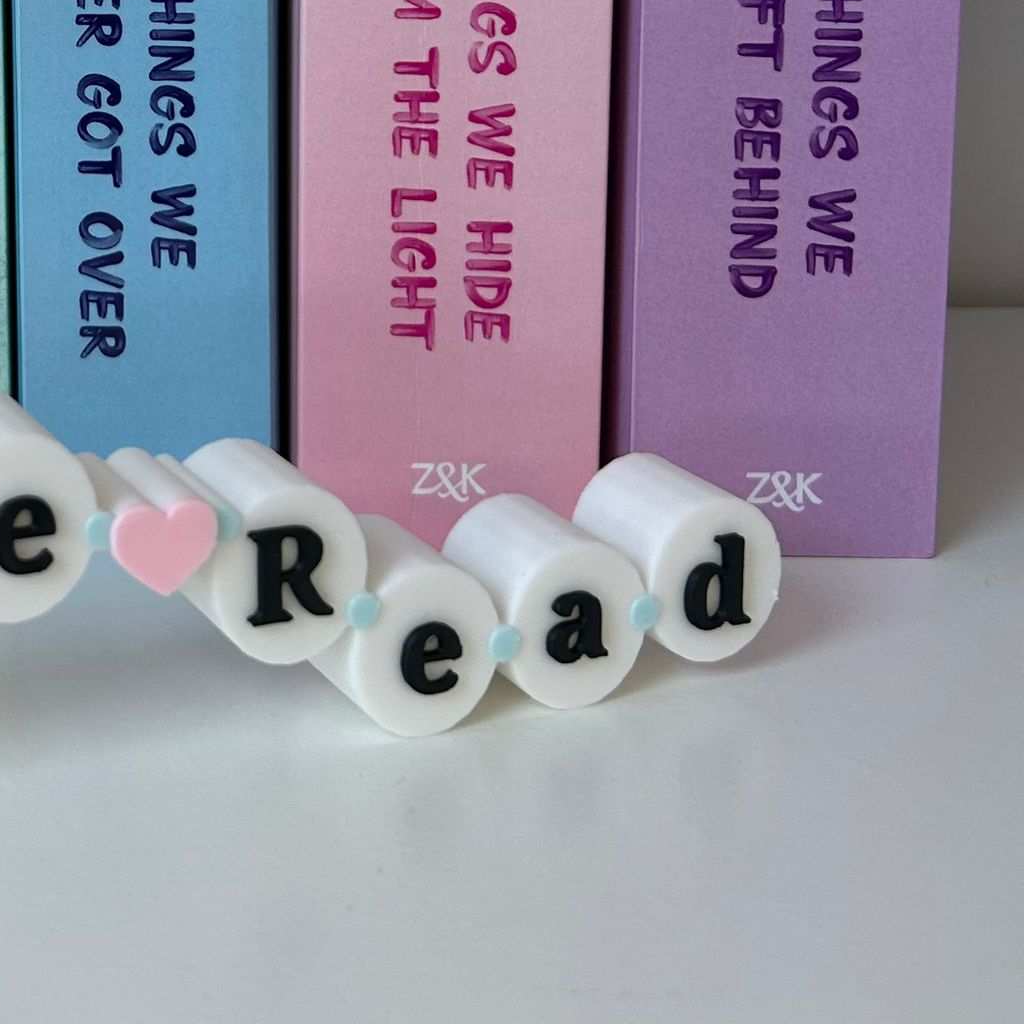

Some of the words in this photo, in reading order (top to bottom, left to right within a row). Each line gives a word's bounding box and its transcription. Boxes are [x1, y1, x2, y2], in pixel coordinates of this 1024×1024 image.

[76, 74, 123, 188] GOT
[391, 48, 440, 159] THE
[466, 103, 516, 190] WE
[151, 184, 197, 270] WE
[728, 97, 783, 298] BEHIND
[806, 189, 857, 276] WE
[78, 212, 126, 359] OVER
[389, 188, 438, 350] LIGHT
[463, 221, 514, 343] HIDE
[411, 463, 487, 501] Z&K
[745, 472, 822, 511] Z&K
